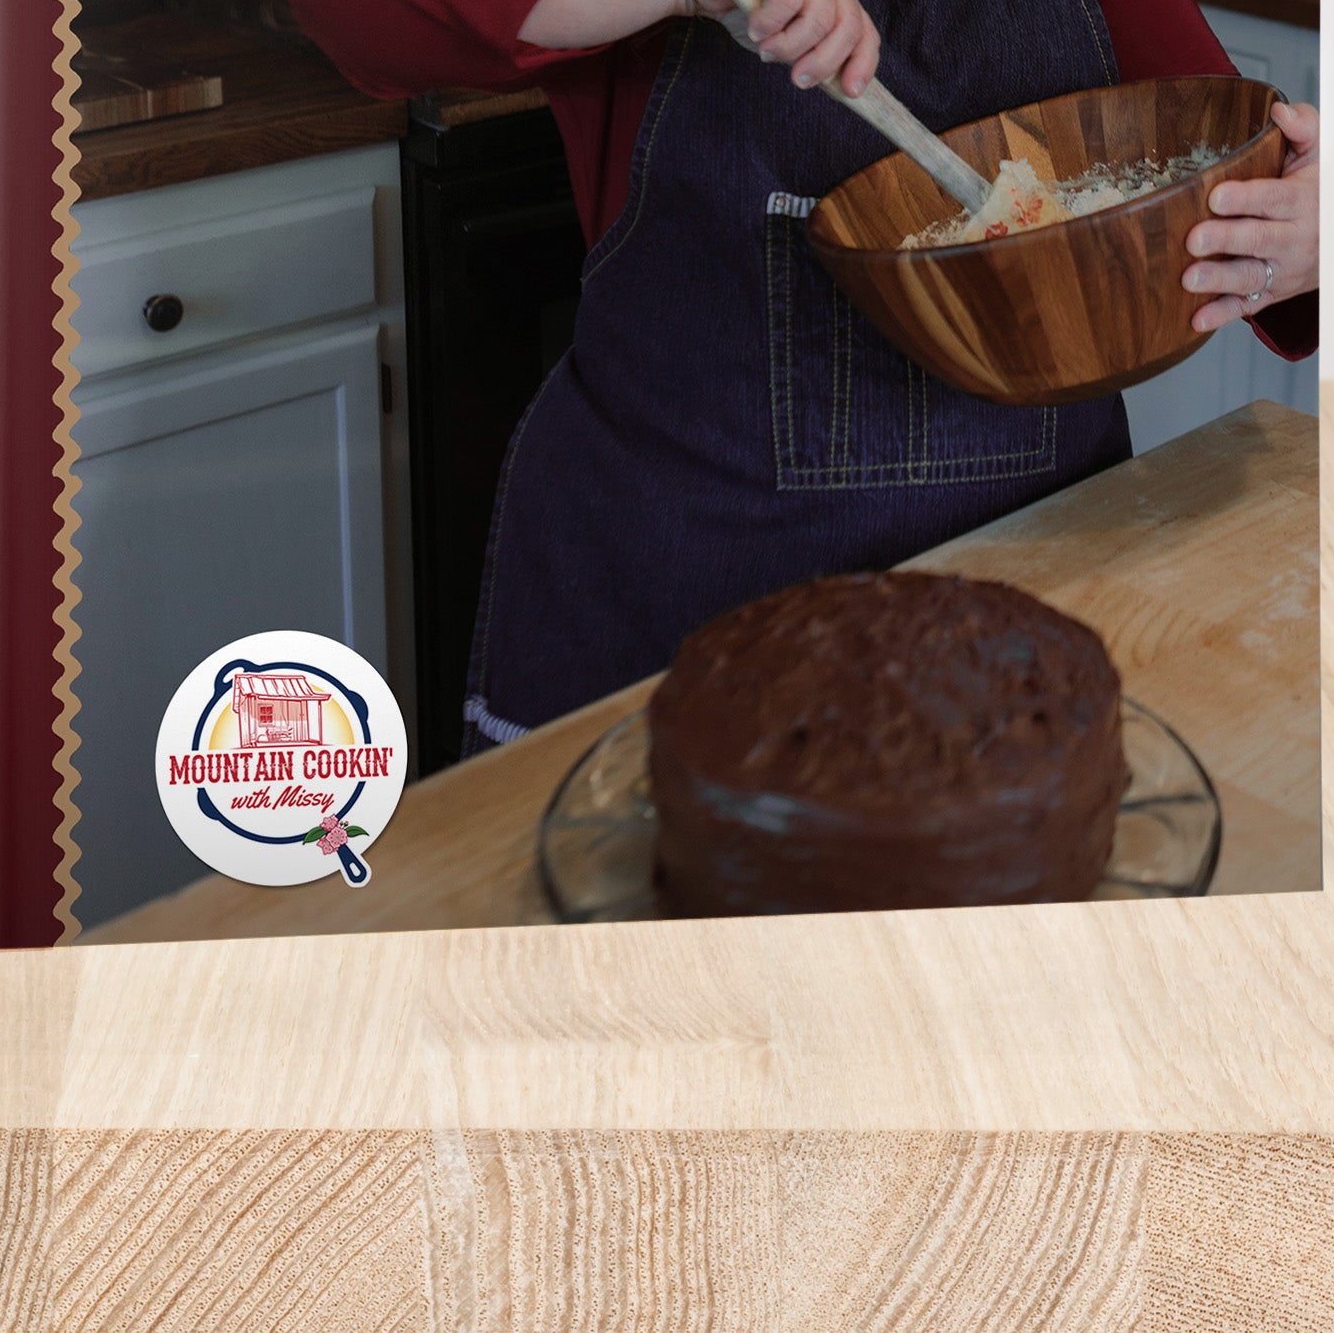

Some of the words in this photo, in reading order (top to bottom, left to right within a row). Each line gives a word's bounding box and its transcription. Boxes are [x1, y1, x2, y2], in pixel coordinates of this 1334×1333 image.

[169, 751, 295, 785] MOUNTAIN
[302, 747, 394, 780] COOKIN'
[231, 786, 271, 810] with
[271, 785, 335, 814] Missy
